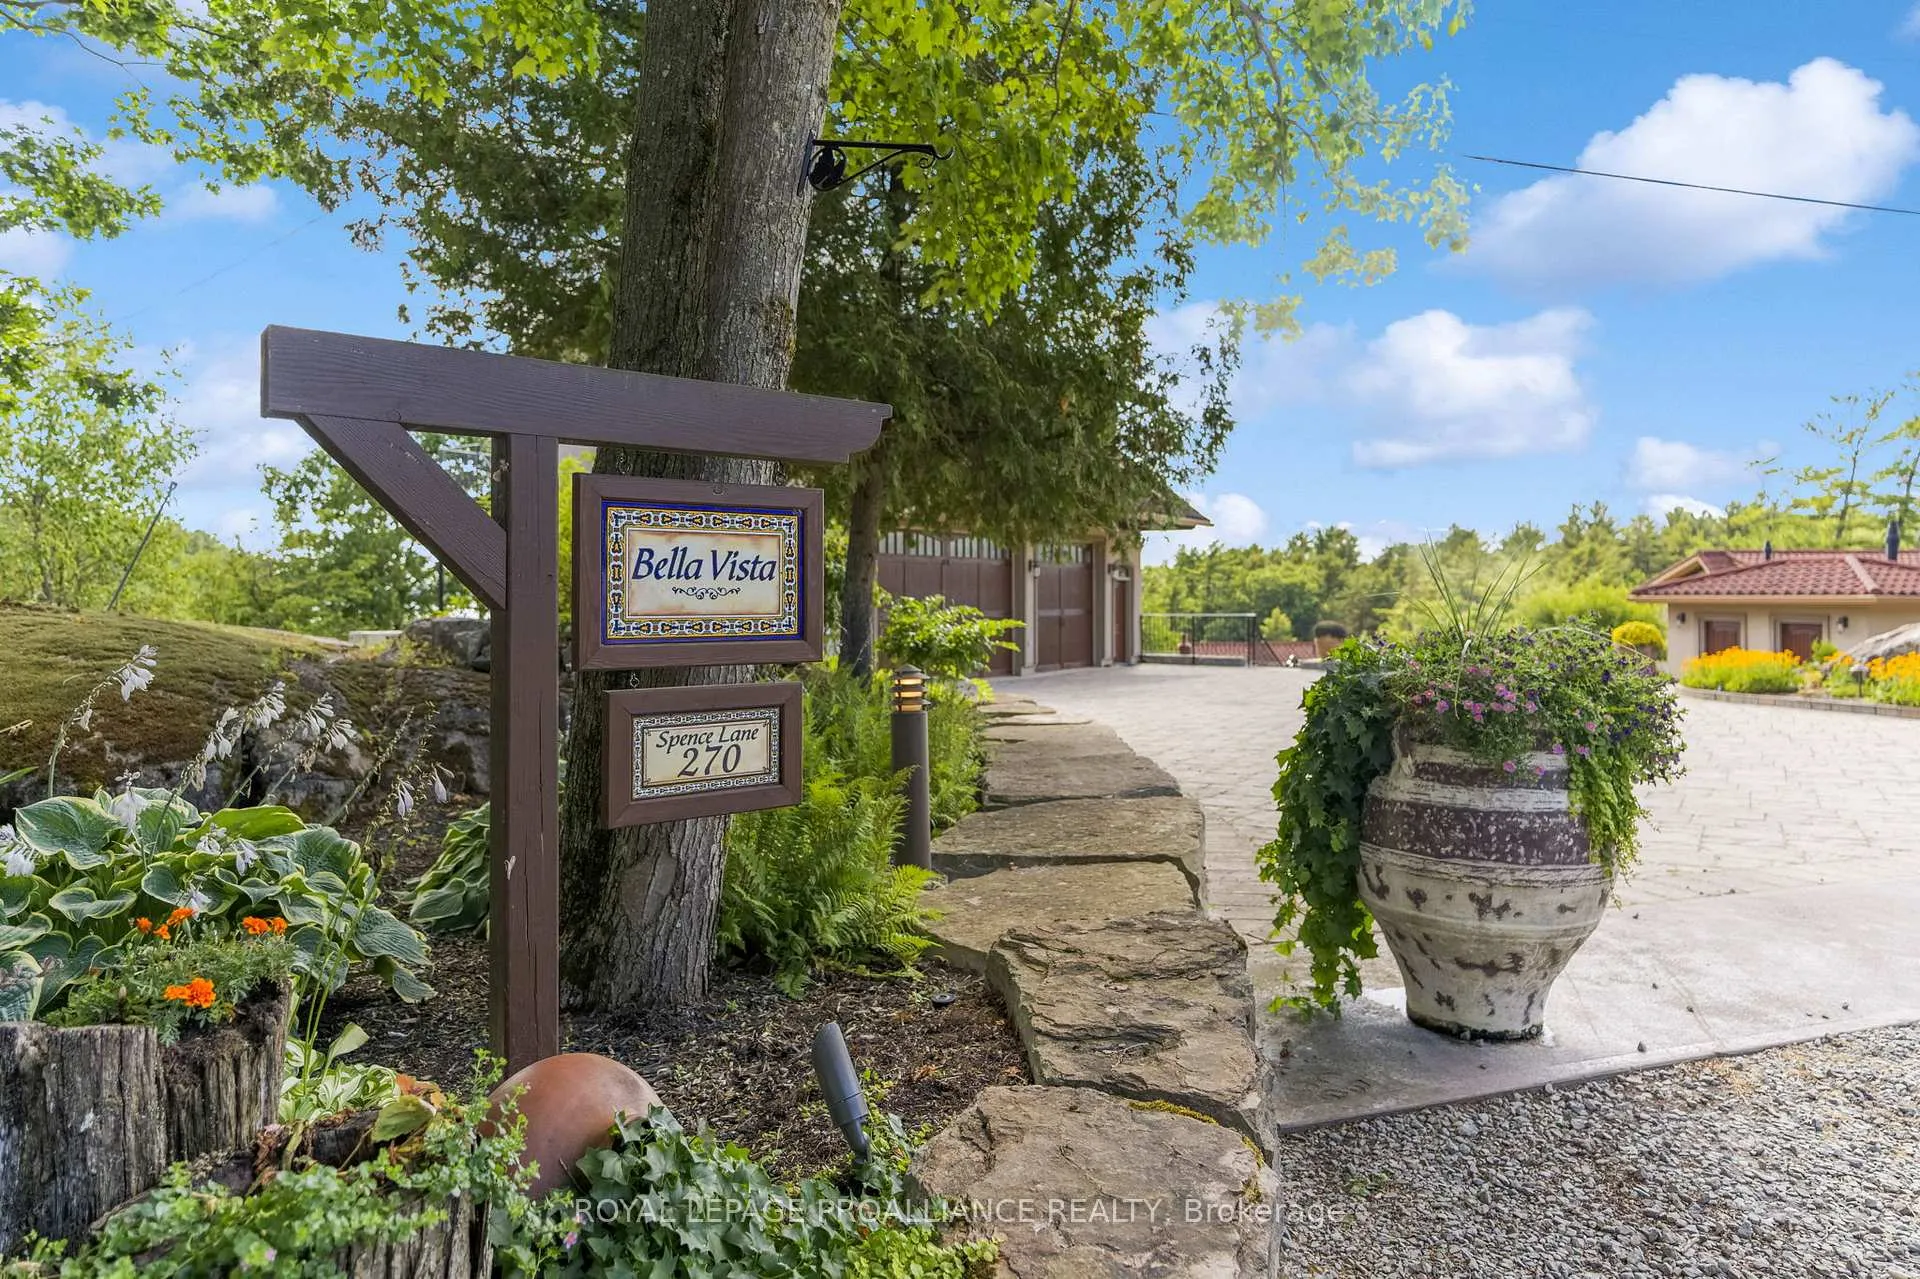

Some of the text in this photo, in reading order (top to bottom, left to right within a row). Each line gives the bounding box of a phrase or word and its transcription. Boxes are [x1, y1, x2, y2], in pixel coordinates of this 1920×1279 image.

[632, 546, 777, 581] Bella Vista
[656, 726, 759, 754] Spence Lane
[677, 743, 741, 778] 270
